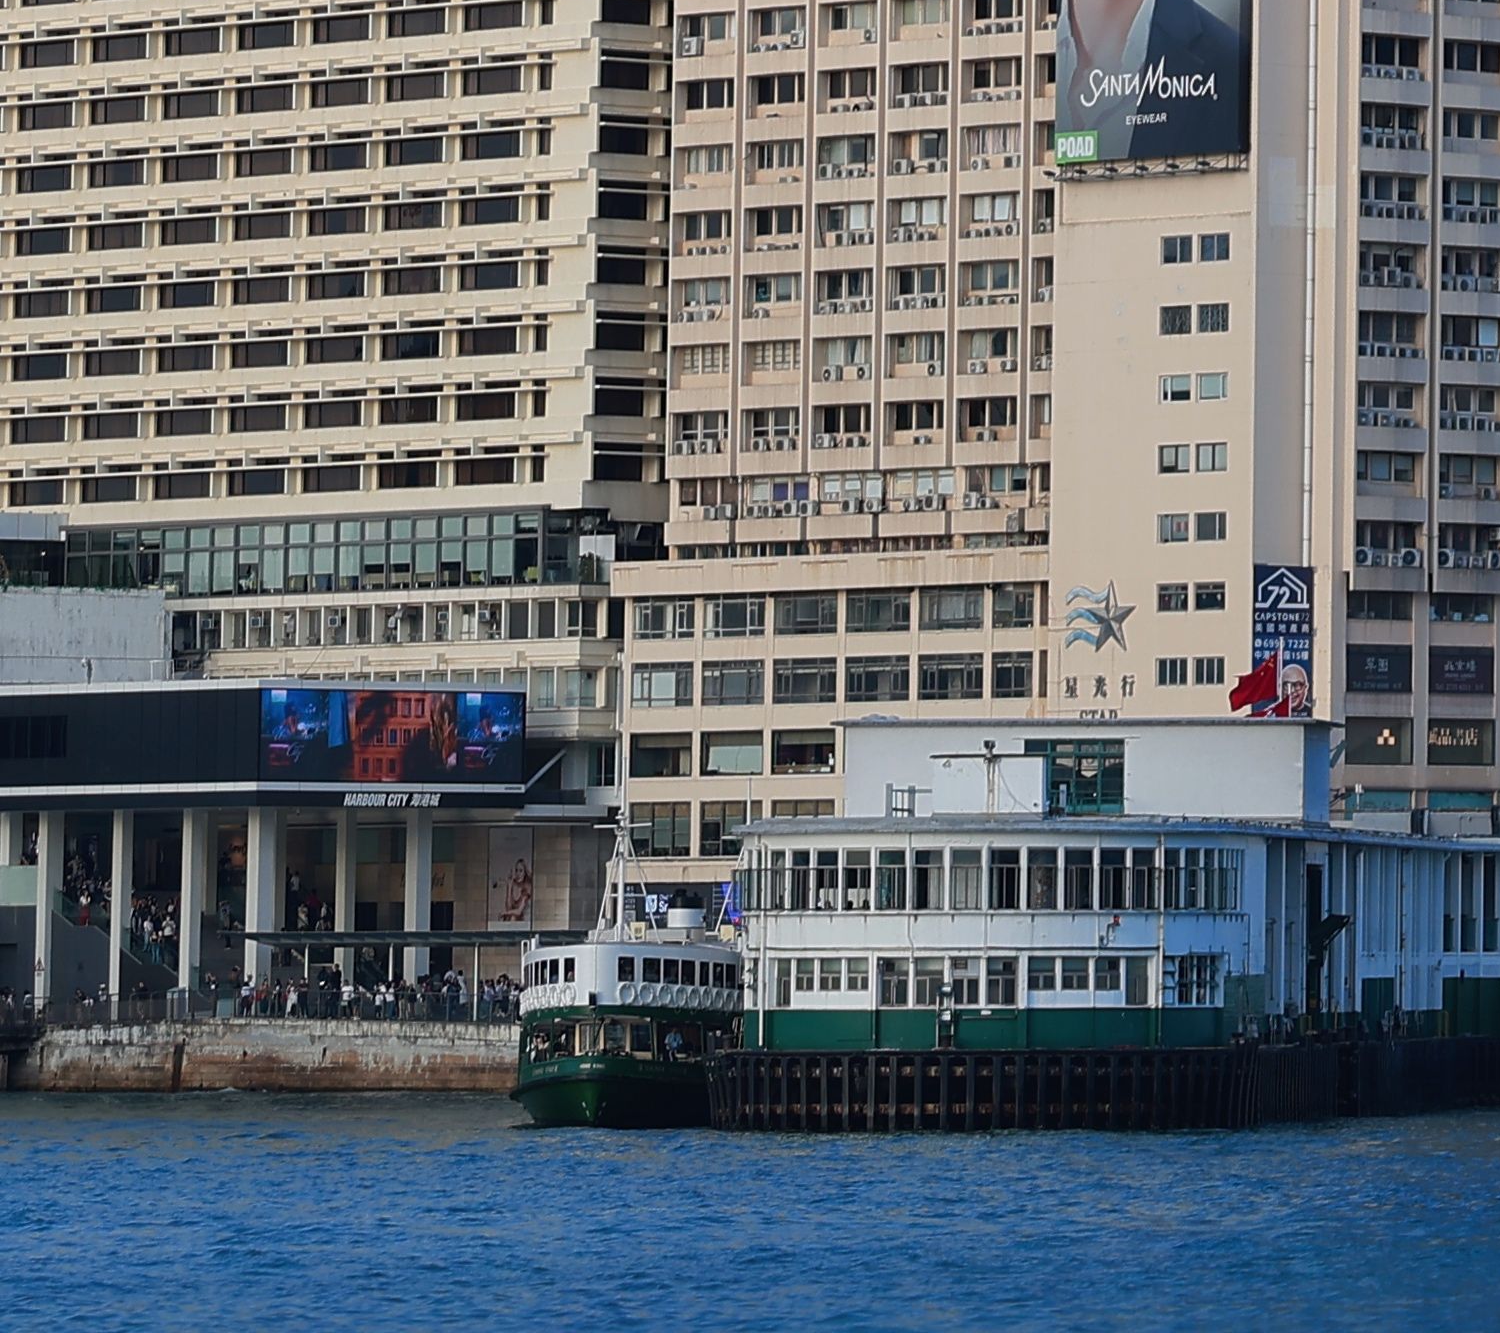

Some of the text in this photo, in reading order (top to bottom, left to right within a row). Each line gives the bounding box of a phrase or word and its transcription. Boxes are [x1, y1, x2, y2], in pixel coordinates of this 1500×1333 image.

[1126, 112, 1167, 126] EYEWEAR
[1057, 136, 1094, 159] POAD
[1287, 638, 1310, 649] 7222
[1063, 674, 1136, 700] 星光行
[343, 792, 387, 807] HARBOUR
[387, 792, 410, 807] CITY
